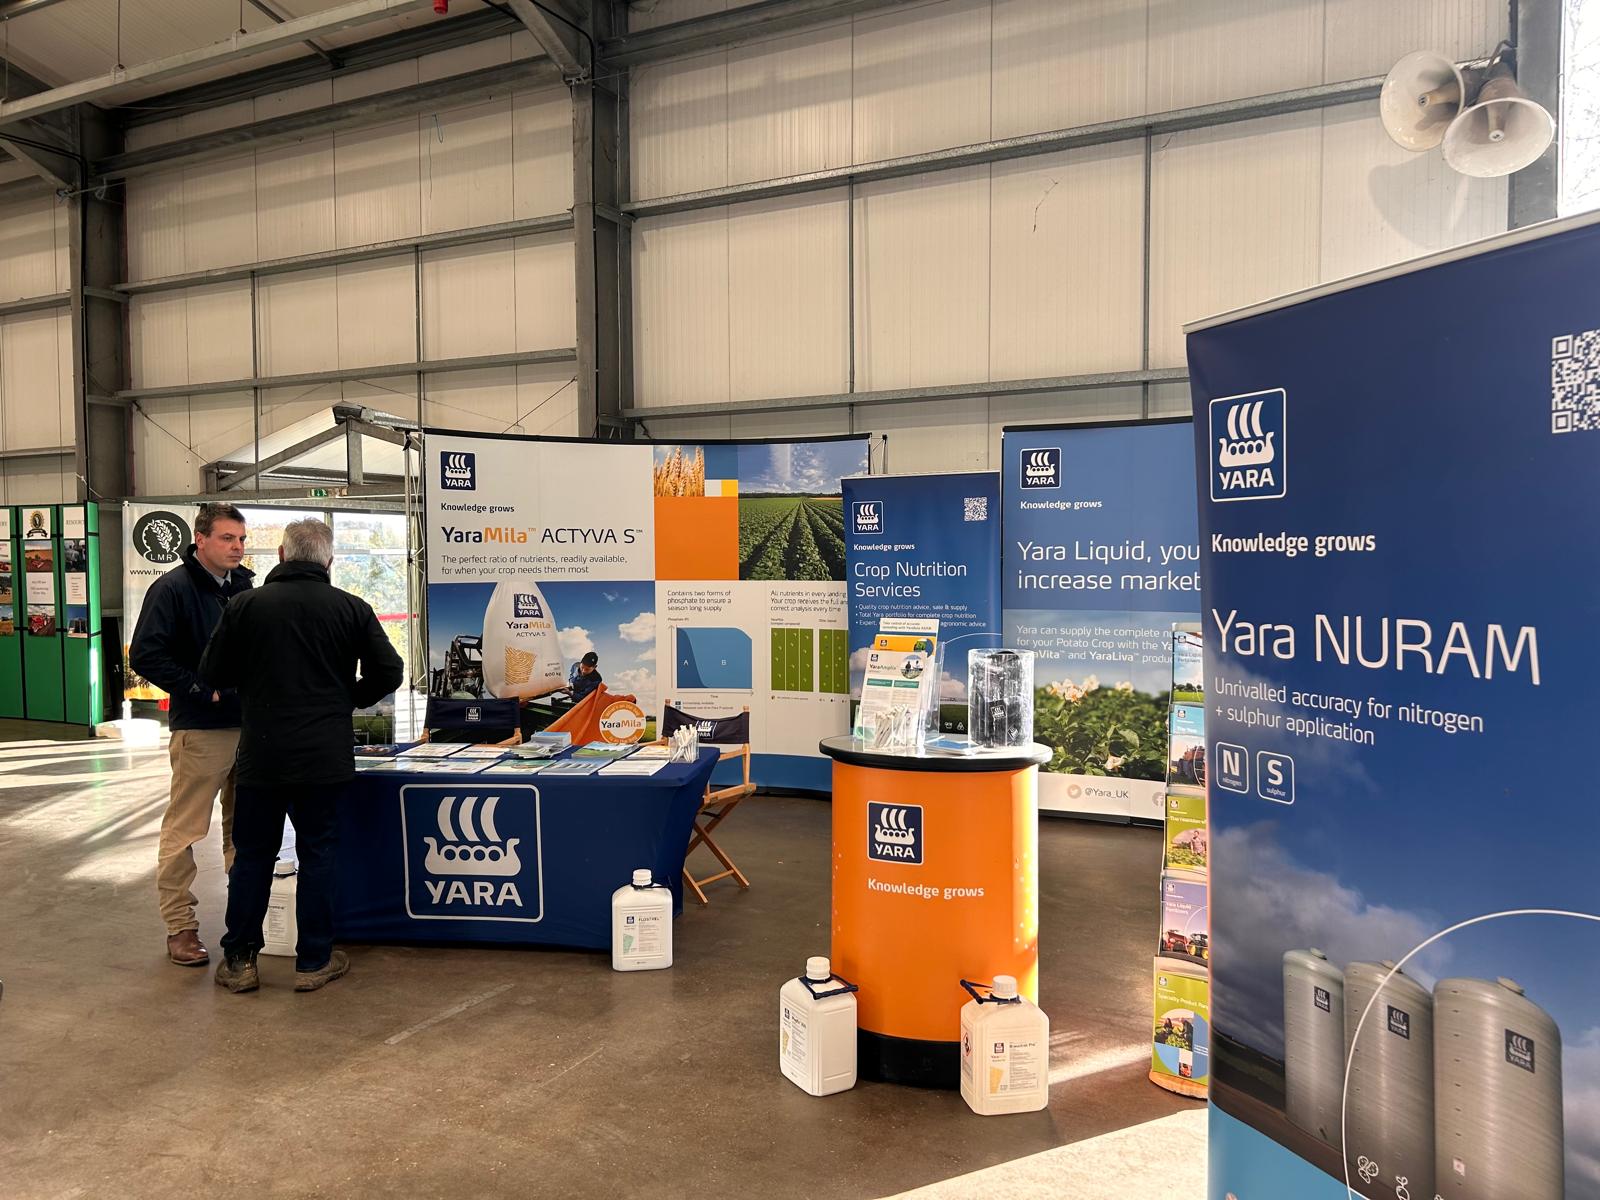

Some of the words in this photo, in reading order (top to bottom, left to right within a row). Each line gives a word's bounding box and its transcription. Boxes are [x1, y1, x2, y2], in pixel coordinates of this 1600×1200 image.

[445, 478, 472, 488] YARA
[1026, 477, 1055, 485] YARA
[1219, 467, 1275, 490] YARA
[441, 502, 487, 513] Knowledge
[489, 504, 515, 513] grows
[1020, 501, 1072, 510] Knowledge
[1074, 501, 1102, 510] grows
[541, 528, 617, 544] ACTYVA
[853, 543, 892, 551] Knowledge
[894, 543, 915, 551] grows
[1017, 541, 1066, 561] Yara
[1075, 540, 1151, 564] Liquid,
[1212, 532, 1309, 557] Knowledge
[1314, 534, 1376, 557] grows
[441, 555, 457, 564] The
[459, 555, 487, 565] perfect
[489, 555, 508, 564] ratio
[509, 555, 518, 564] of
[520, 555, 558, 564] nutrients,
[560, 555, 587, 566] readily
[589, 555, 628, 565] available,
[441, 566, 452, 575] for
[478, 568, 496, 576] your
[498, 568, 515, 576] crop
[544, 566, 566, 574] them
[855, 562, 890, 580] Crop
[896, 562, 967, 577] Nutrition
[1018, 570, 1112, 590] increase
[1120, 570, 1201, 590] market
[855, 582, 921, 597] Services
[1016, 625, 1037, 635] Yara
[1060, 626, 1091, 637] supply
[1095, 626, 1110, 636] the
[1113, 627, 1160, 638] complete
[1016, 638, 1029, 646] for
[1033, 639, 1053, 648] your
[1056, 638, 1088, 648] Potato
[1091, 639, 1114, 650] Crop
[1118, 640, 1138, 649] with
[1142, 640, 1158, 650] the
[1212, 608, 1295, 660] Yara
[1315, 614, 1540, 685] NURAM
[1068, 651, 1086, 660] and
[1215, 677, 1286, 703] Unrivalled
[1292, 689, 1362, 718] accuracy
[1367, 697, 1392, 719] for
[1398, 703, 1484, 734] nitrogen
[1216, 706, 1223, 716] +
[1227, 706, 1281, 728] sulphur
[1286, 715, 1375, 745] application
[1223, 749, 1240, 776] N
[1268, 760, 1283, 785] S
[1085, 788, 1129, 798] @Yara_UK
[1266, 788, 1286, 796] sulphur
[874, 844, 915, 859] YARA
[424, 880, 523, 907] YARA
[868, 878, 939, 898] Knowledge
[944, 886, 984, 899] grows
